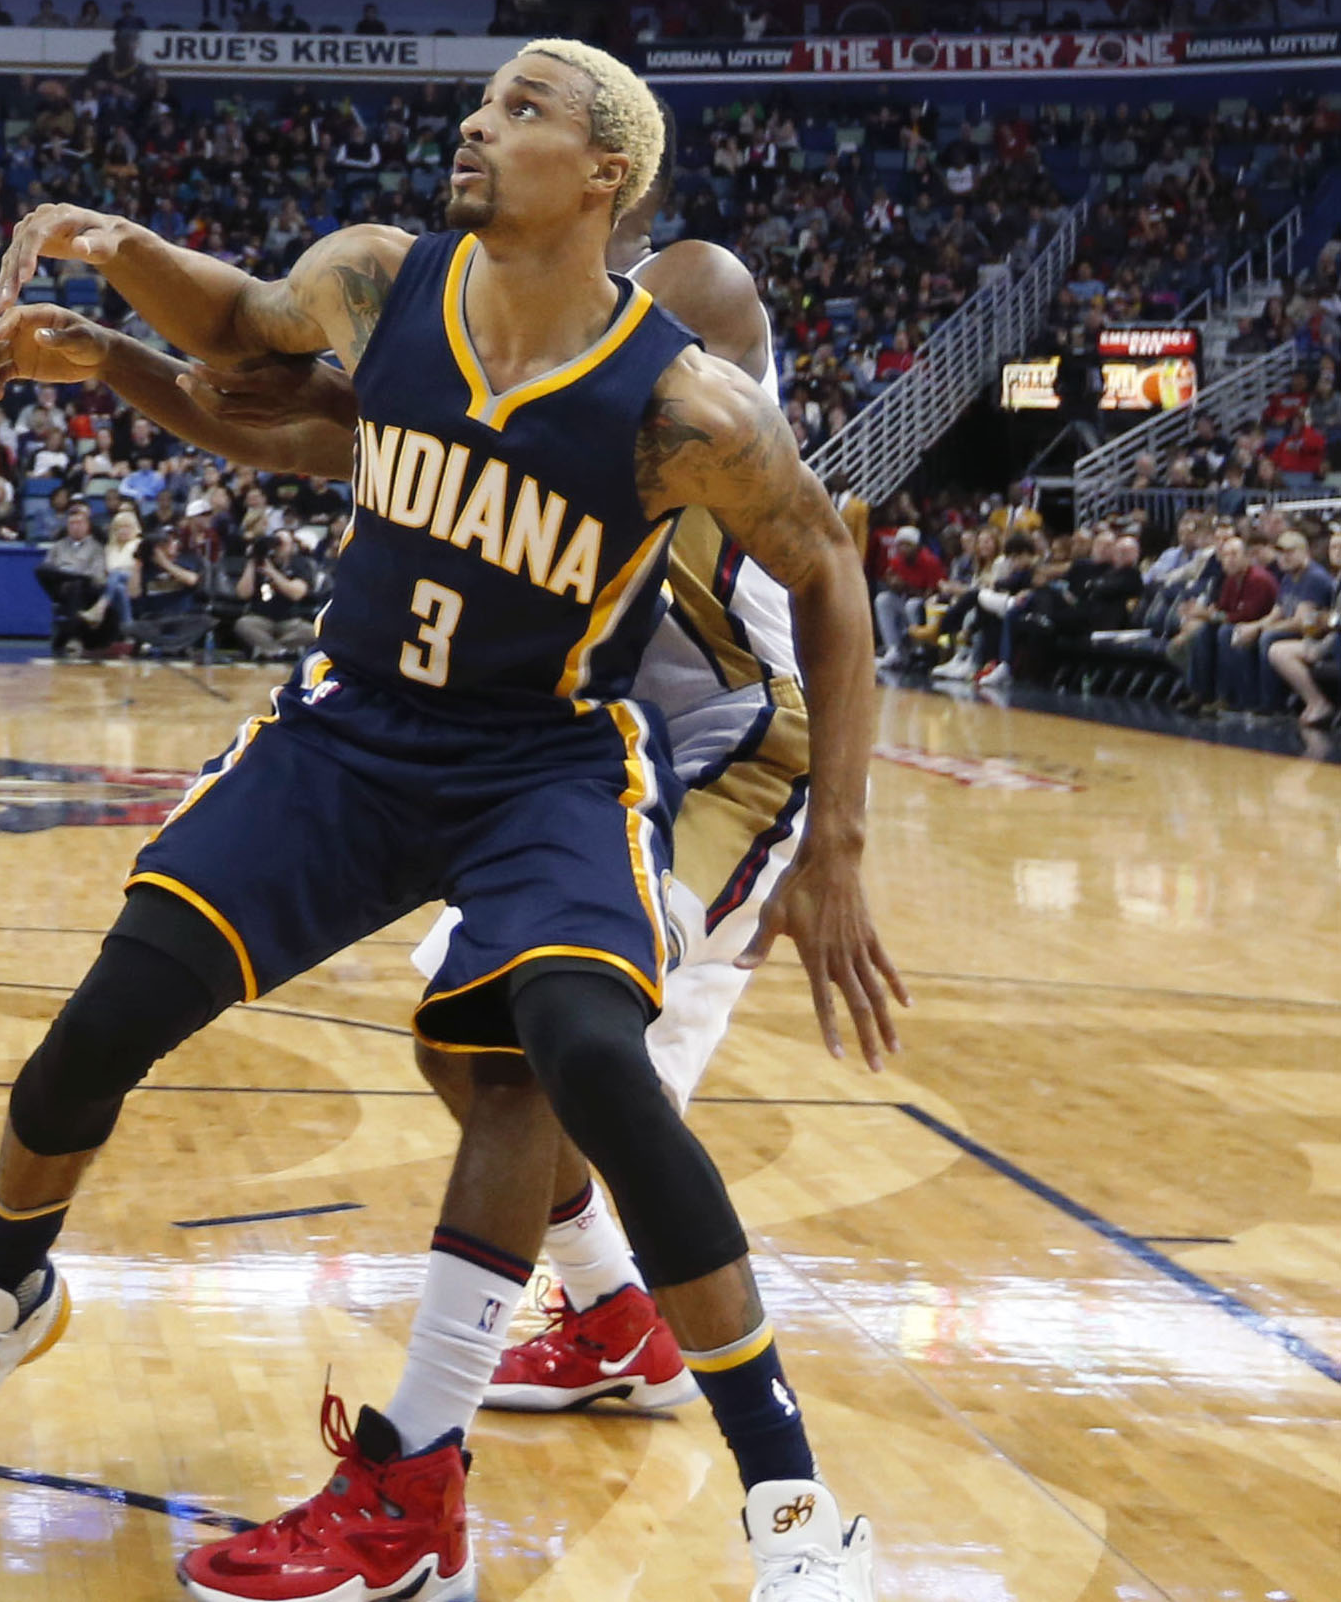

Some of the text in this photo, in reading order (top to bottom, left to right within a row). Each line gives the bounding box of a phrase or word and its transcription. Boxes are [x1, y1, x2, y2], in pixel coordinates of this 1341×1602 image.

[153, 35, 419, 65] JRUE'S KREWE
[646, 48, 794, 68] LOUISIANA LOTTERY
[803, 32, 1178, 71] THE LOTTERY ZONE
[1185, 33, 1340, 59] LOUISIANA LOTTERY
[1099, 331, 1192, 347] EMERGENCY
[356, 416, 604, 605] INDIANA
[398, 577, 464, 688] 3
